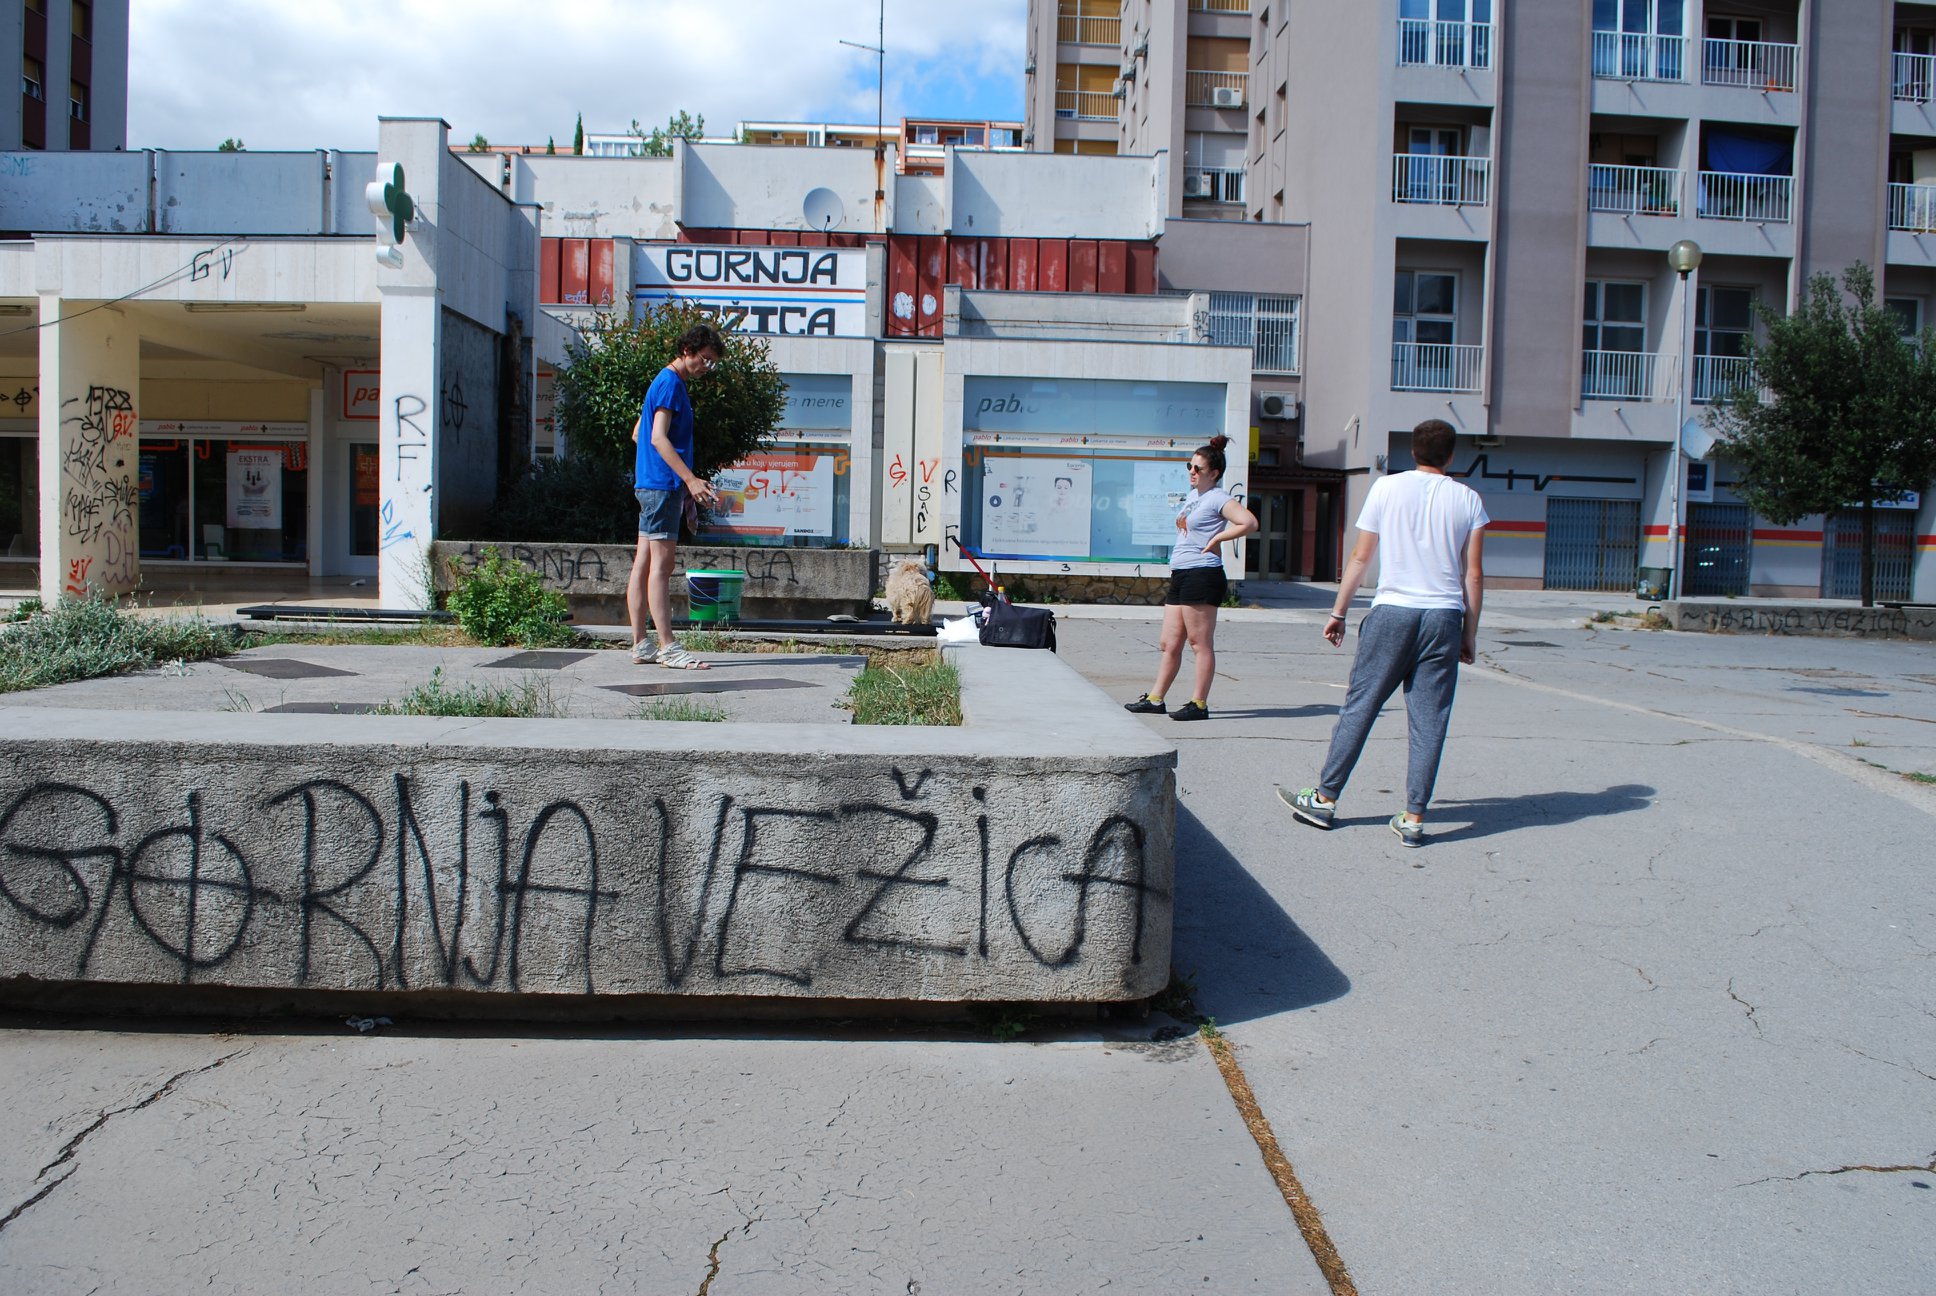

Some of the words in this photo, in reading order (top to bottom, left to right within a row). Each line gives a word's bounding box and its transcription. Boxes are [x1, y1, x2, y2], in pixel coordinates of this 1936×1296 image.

[667, 249, 838, 285] GORNJA
[801, 397, 844, 408] mene
[973, 433, 992, 441] pablo
[1060, 436, 1079, 444] pablo
[1147, 439, 1166, 447] pablo
[238, 455, 269, 463] EKSTRA
[768, 460, 798, 468] vjerujem
